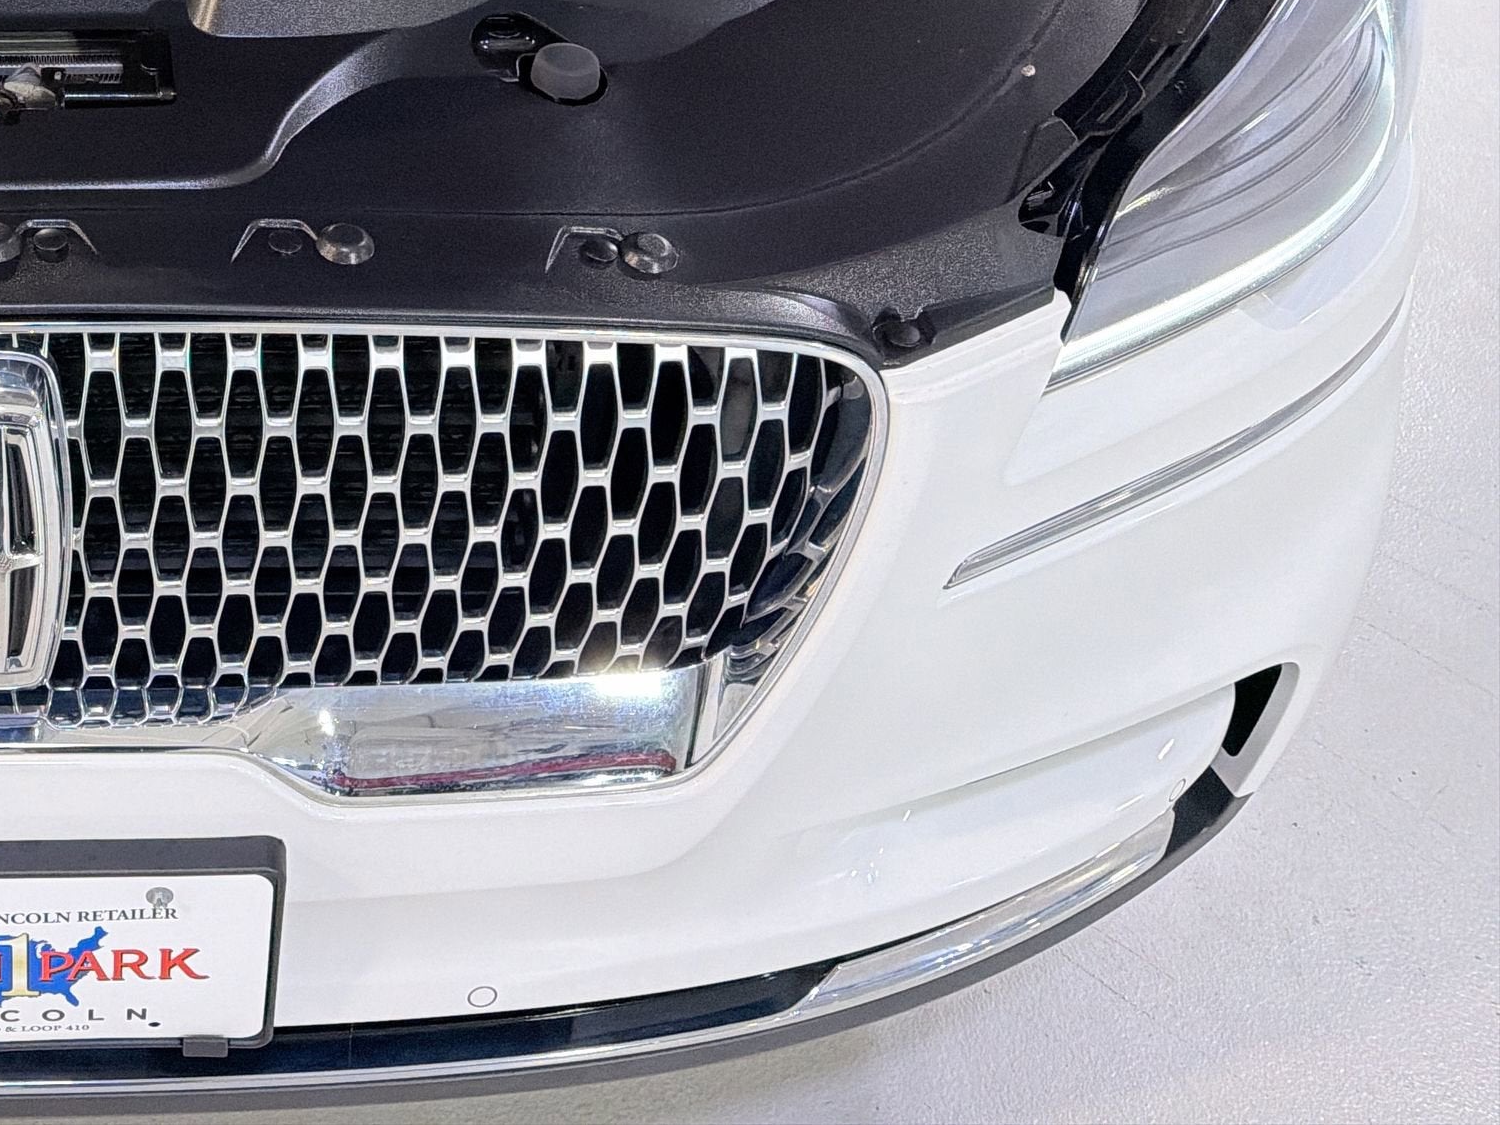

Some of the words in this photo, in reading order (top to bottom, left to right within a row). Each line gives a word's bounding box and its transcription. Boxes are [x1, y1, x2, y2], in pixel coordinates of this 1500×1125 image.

[76, 907, 180, 923] RETAILER
[39, 947, 211, 982] PARK
[4, 1026, 19, 1034] &
[20, 1024, 62, 1033] LOOP
[65, 1023, 91, 1032] 410
